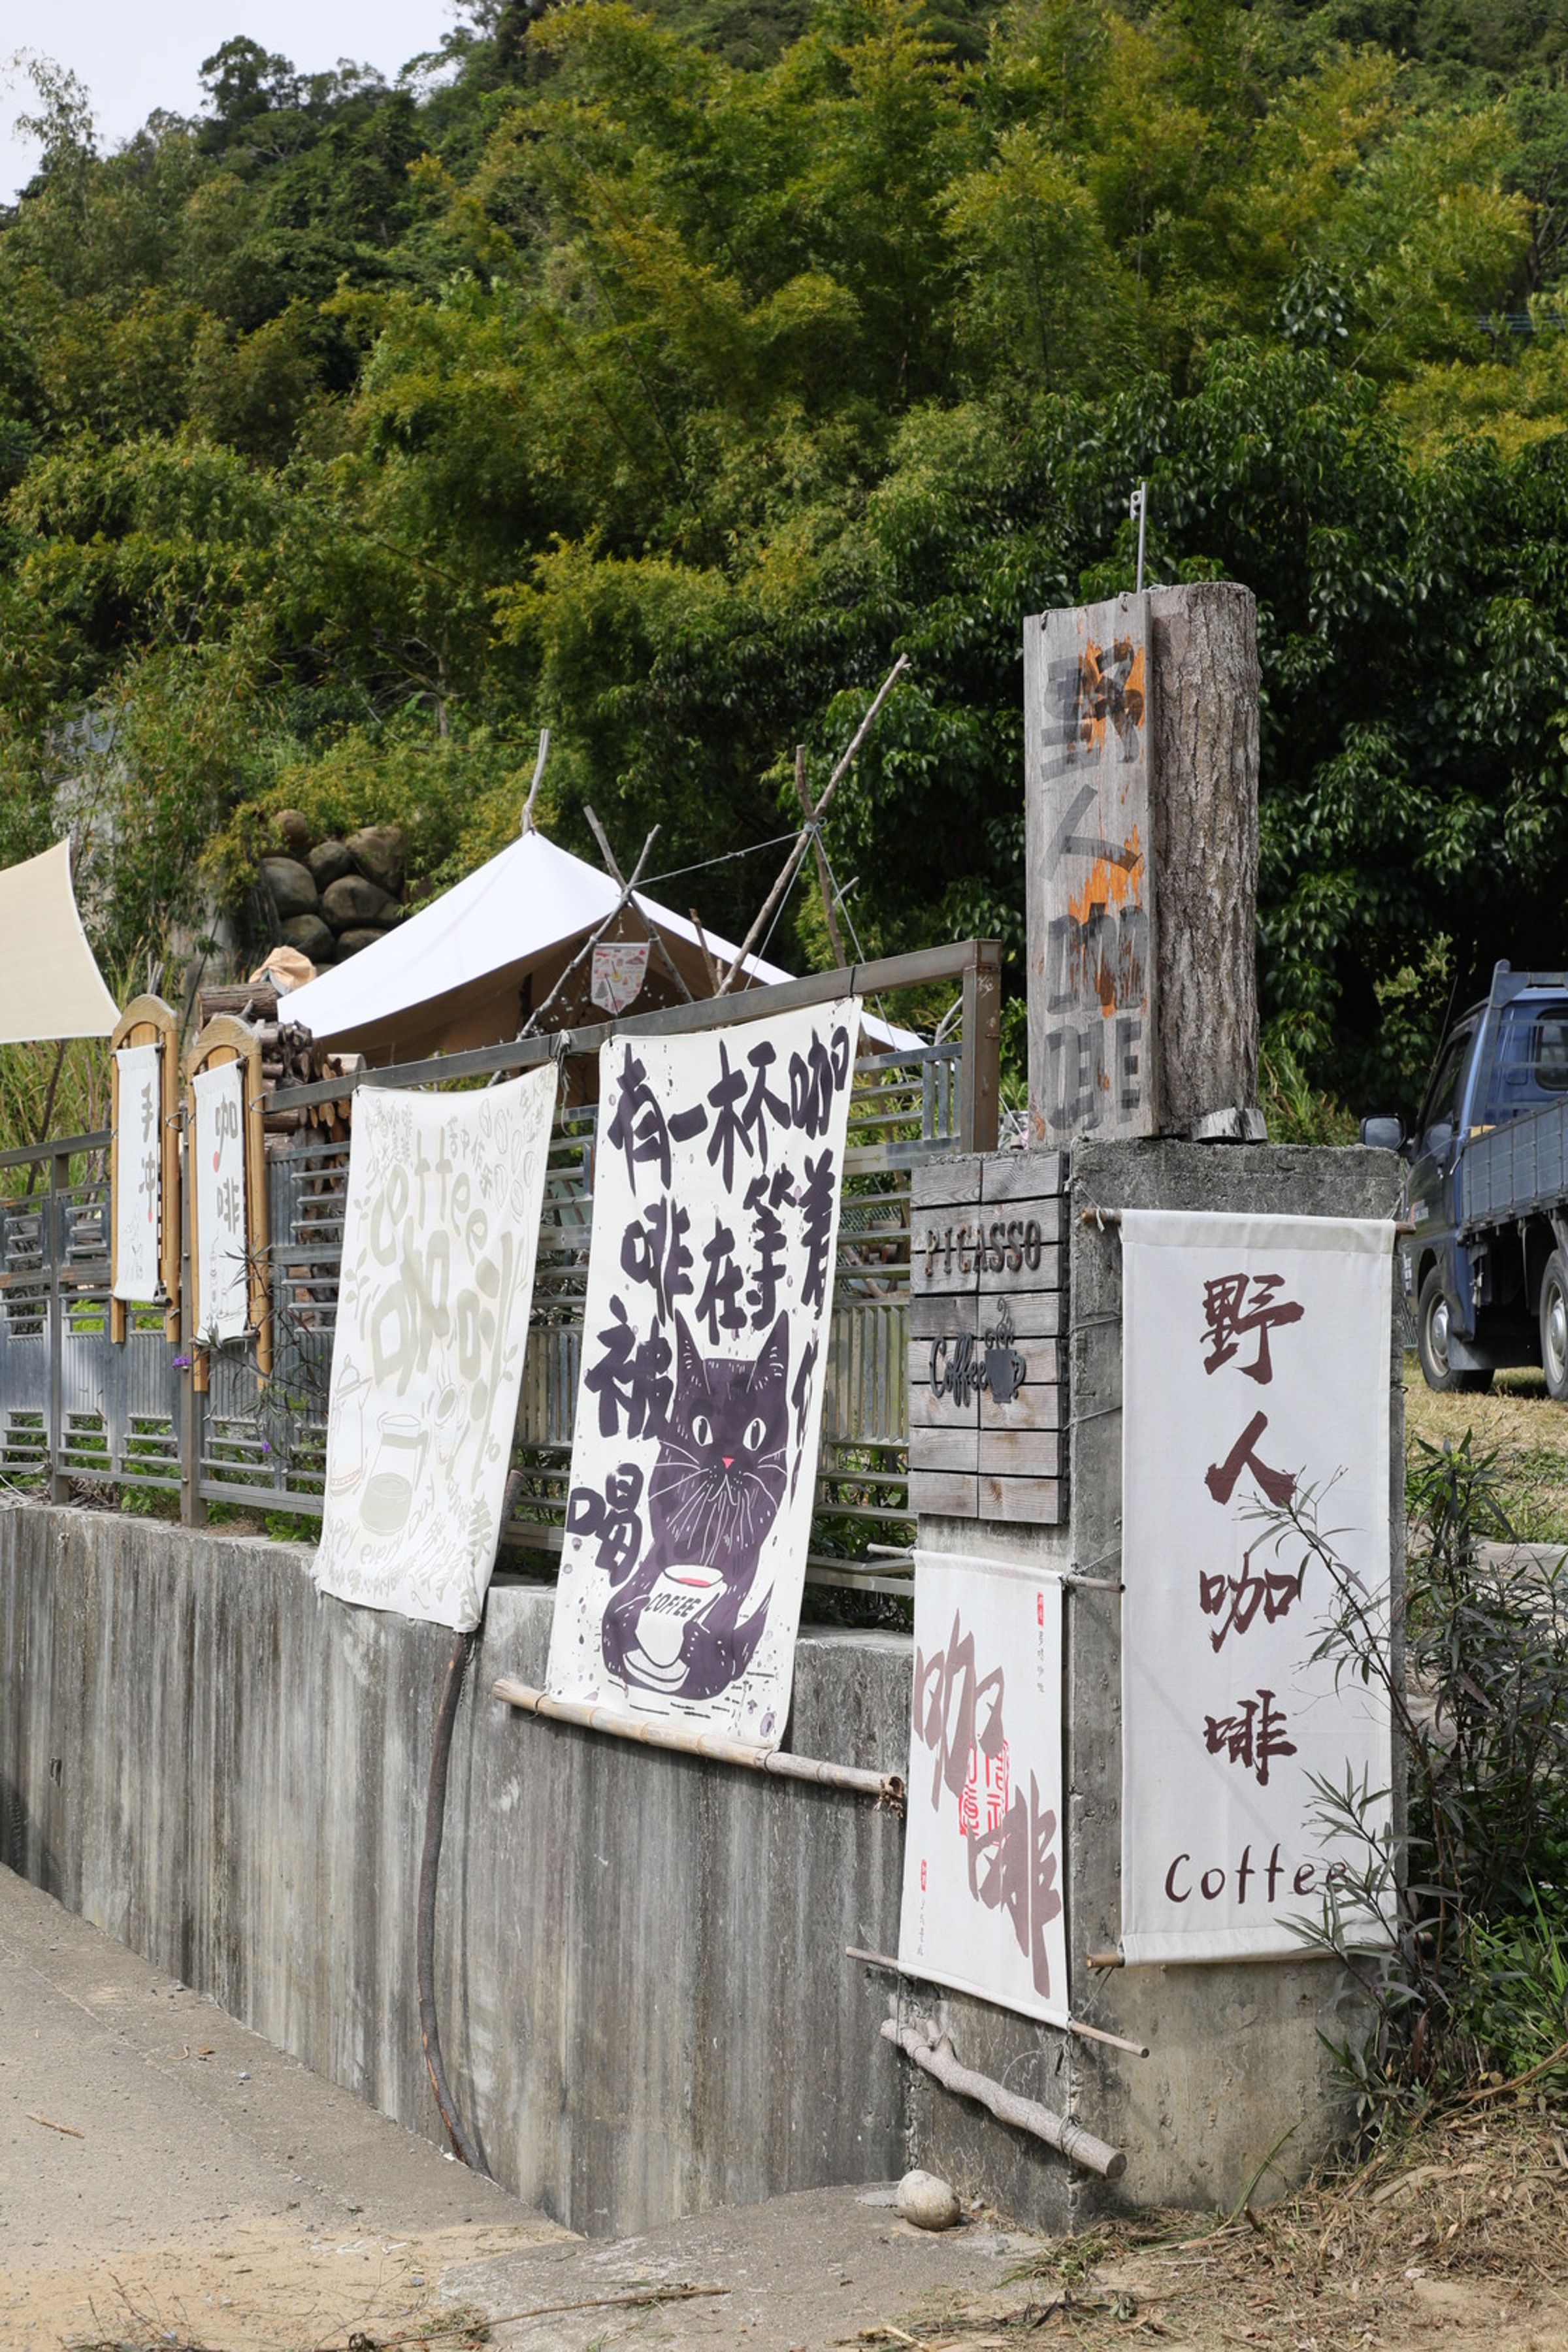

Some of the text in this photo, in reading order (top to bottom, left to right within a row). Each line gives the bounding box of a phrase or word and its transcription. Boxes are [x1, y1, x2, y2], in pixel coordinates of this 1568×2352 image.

[1041, 640, 1149, 1132] 野人咖啡
[213, 1094, 239, 1233] 咖啡
[607, 1026, 850, 1196] 有一杯咖
[370, 1125, 488, 1266] Coffee
[924, 1219, 1041, 1277] PICASSO
[370, 1228, 516, 1496] 咖啡
[929, 1332, 987, 1407] Coffee
[1198, 1271, 1304, 1787] 野人咖啡
[644, 1590, 702, 1618] COFFEE
[913, 1608, 1061, 1999] 咖啡
[1164, 1843, 1347, 1904] Coffee
